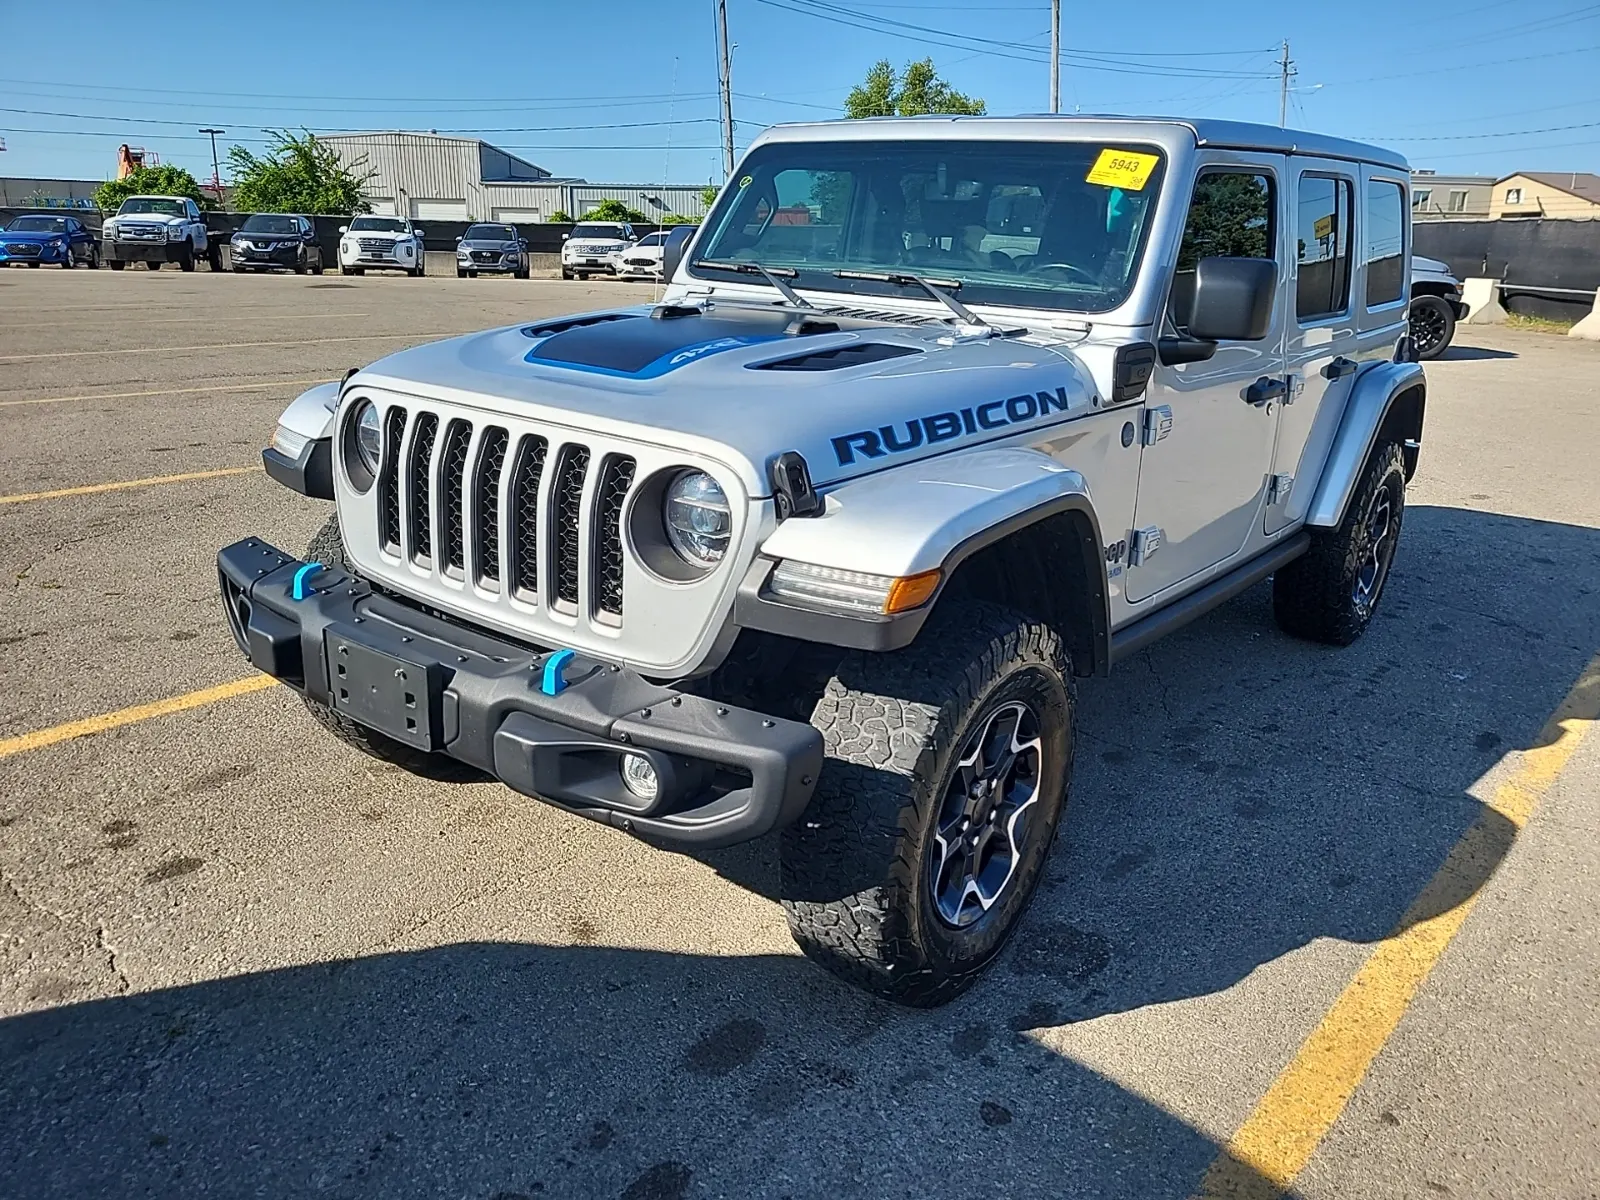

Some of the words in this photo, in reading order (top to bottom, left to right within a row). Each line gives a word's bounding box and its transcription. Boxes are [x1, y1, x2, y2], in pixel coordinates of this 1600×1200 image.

[1109, 158, 1140, 173] 5943
[830, 387, 1069, 467] RUBICON
[1103, 540, 1126, 564] eep
